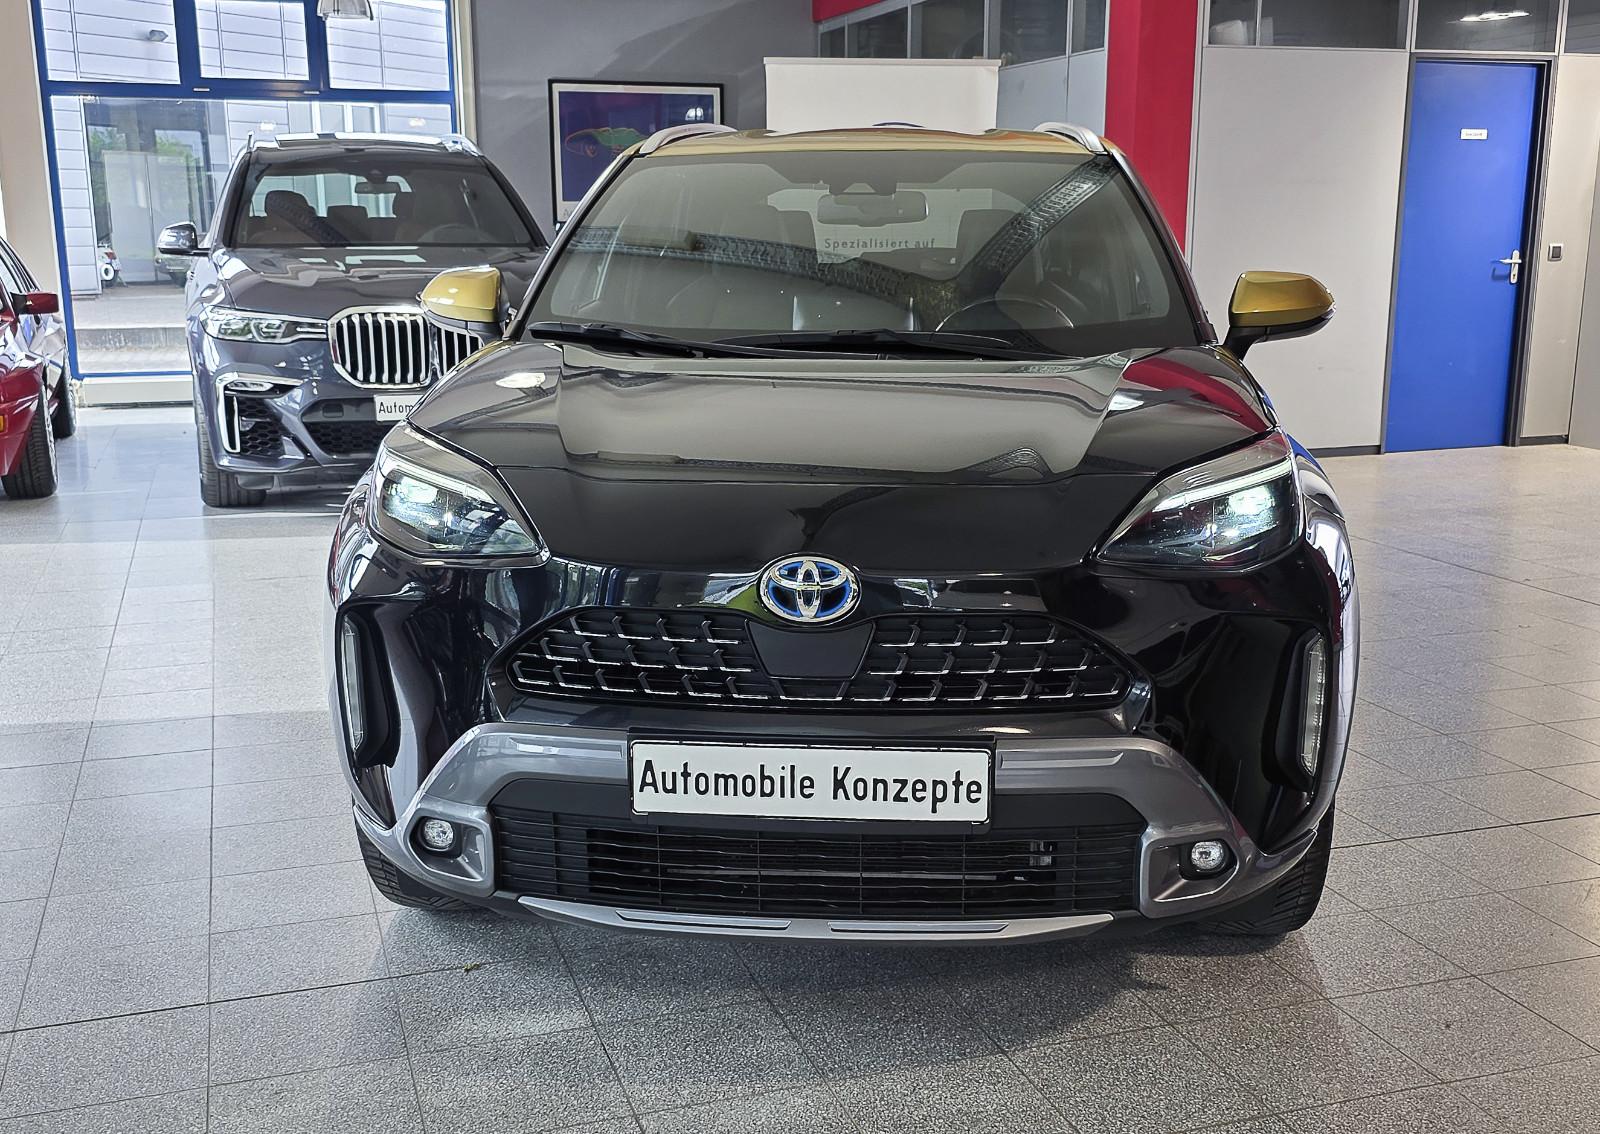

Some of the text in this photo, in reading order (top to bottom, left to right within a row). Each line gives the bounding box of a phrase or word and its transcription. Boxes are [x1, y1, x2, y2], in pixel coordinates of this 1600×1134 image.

[824, 238, 935, 251] Spezialisiert auf
[639, 759, 982, 814] Automobile Konzepte
